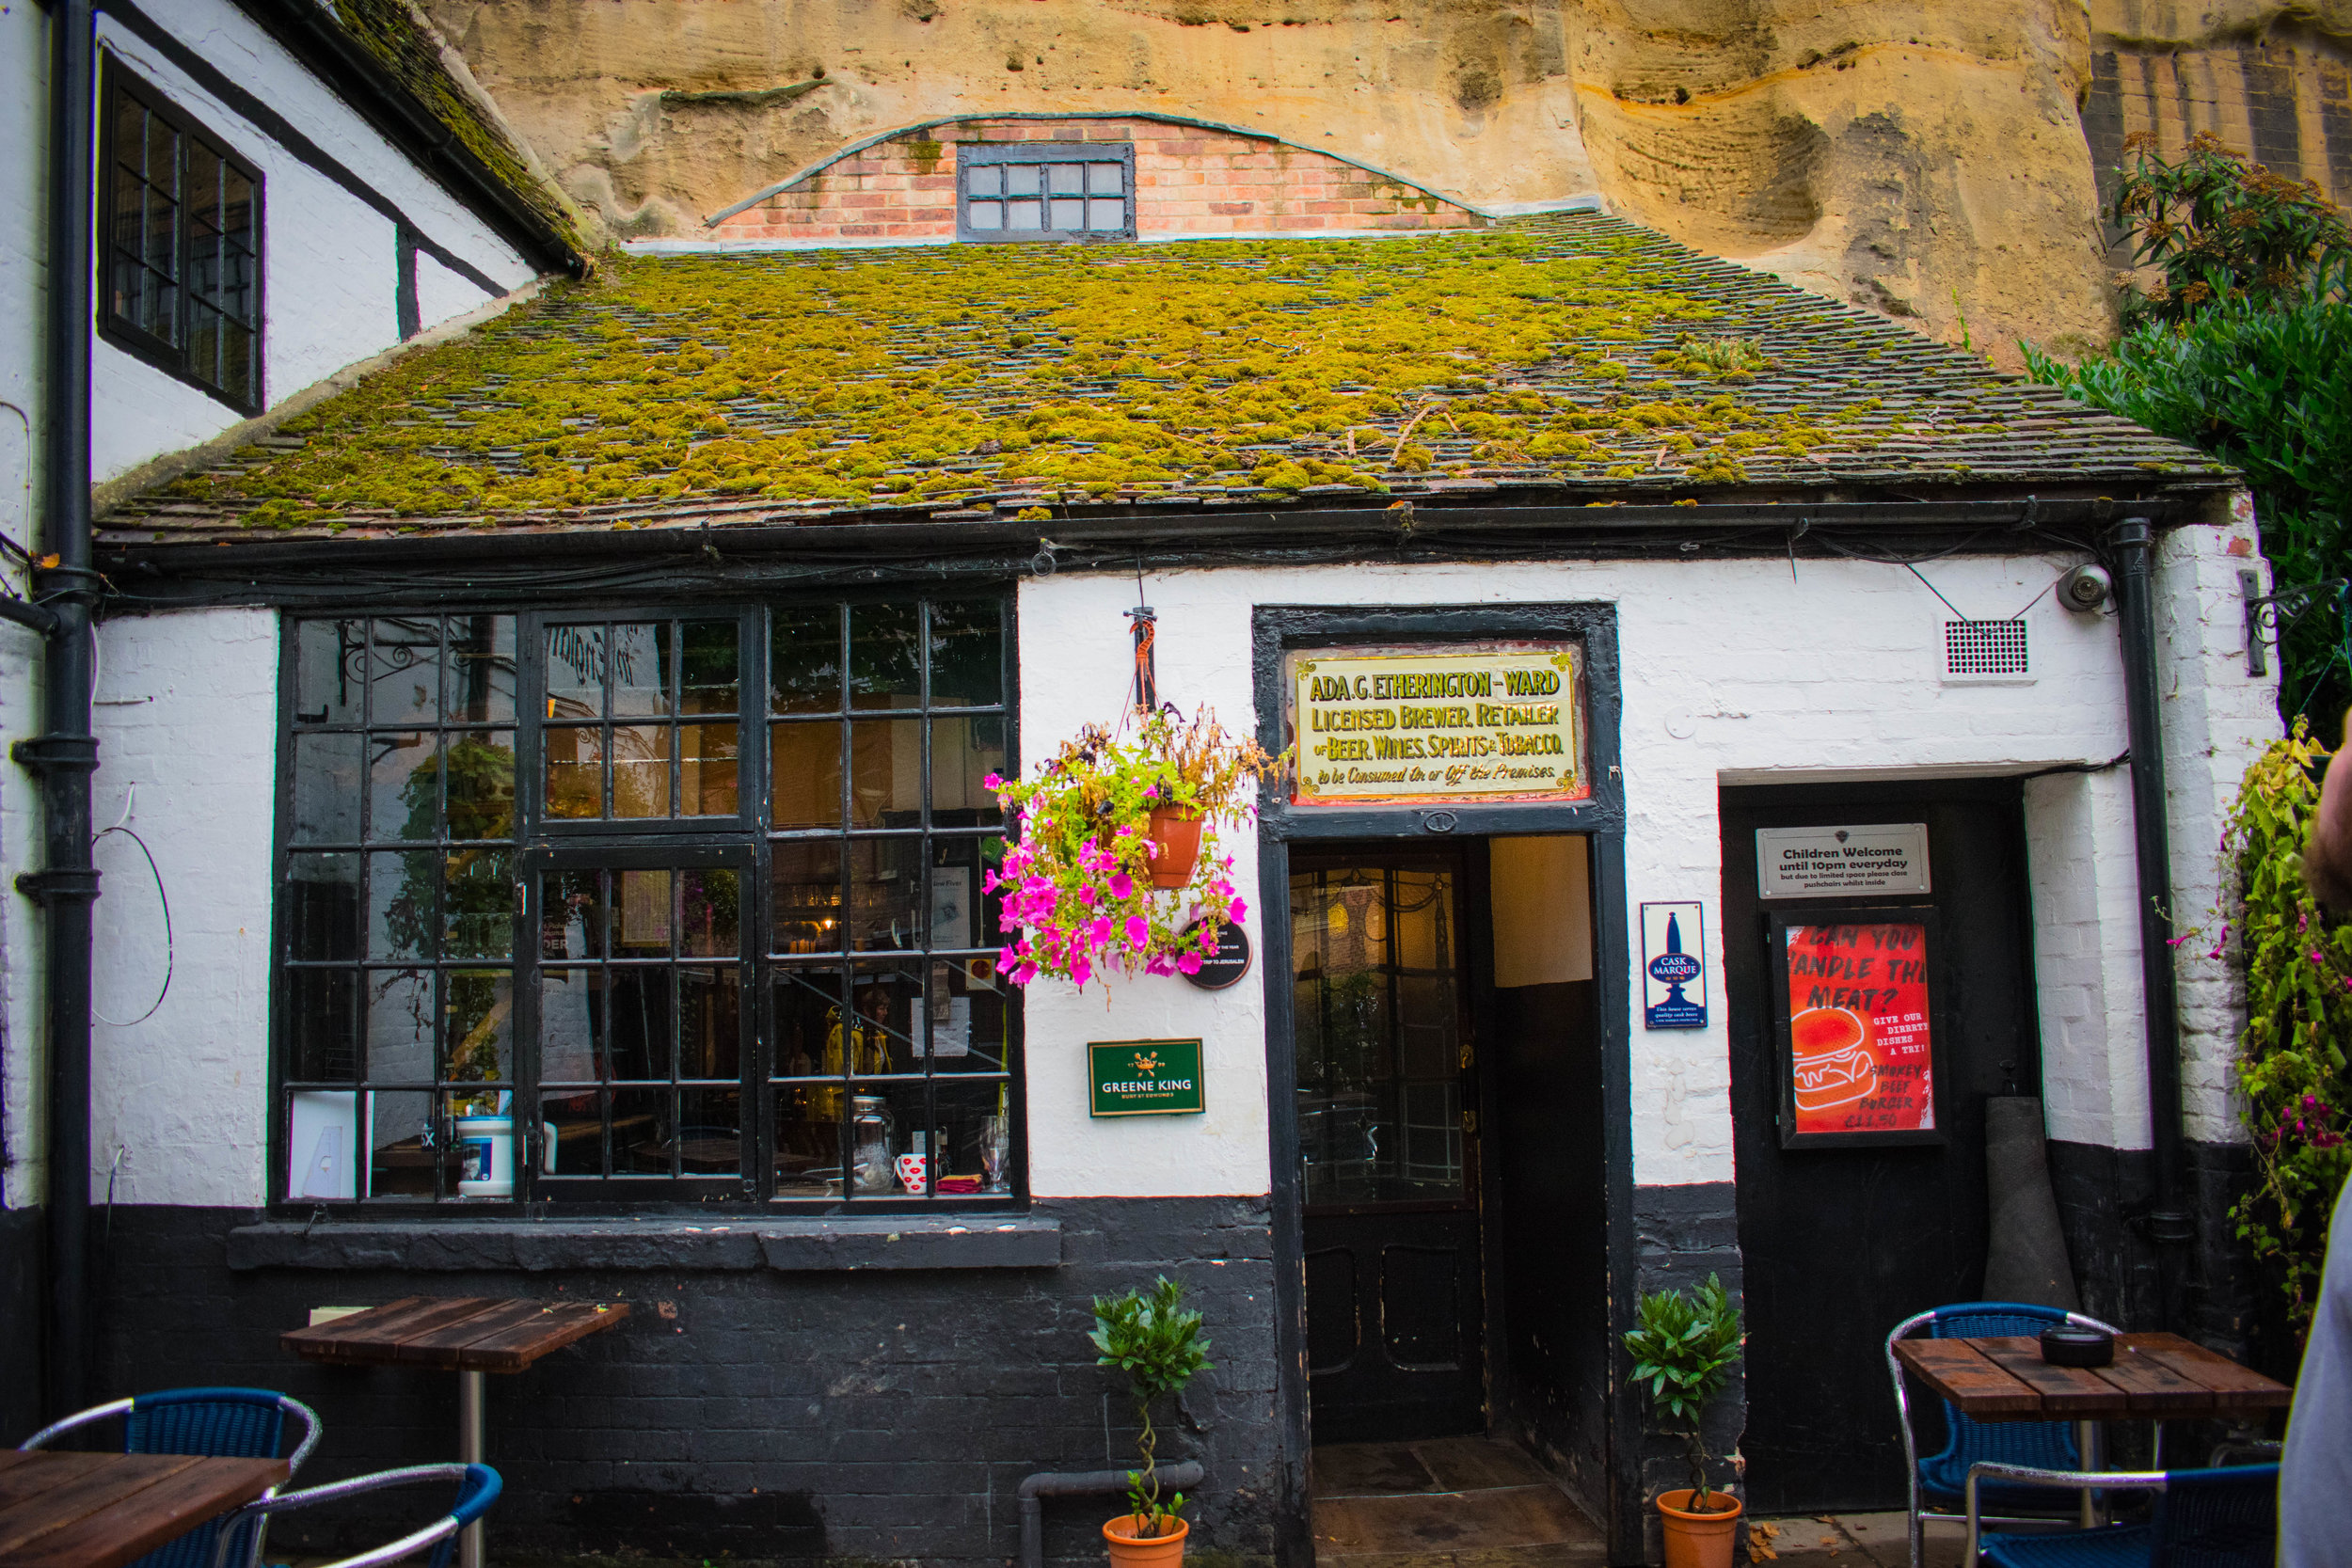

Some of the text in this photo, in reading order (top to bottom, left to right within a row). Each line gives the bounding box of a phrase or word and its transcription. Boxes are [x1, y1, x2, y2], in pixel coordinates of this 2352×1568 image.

[1311, 707, 1397, 732] LICENSED
[1475, 703, 1559, 727] RETAILER
[1313, 744, 1328, 756] OF
[1427, 734, 1489, 759] SPIRITS
[1317, 768, 1330, 784] to
[1331, 767, 1345, 784] be
[1347, 766, 1408, 784] Consumed
[1408, 764, 1425, 783] On
[1427, 769, 1444, 783] or
[1444, 763, 1470, 787] Off
[1469, 763, 1491, 781] the
[1783, 847, 1903, 860] Children Welcome
[1779, 858, 1908, 871] until 10pm everyday
[1809, 927, 1918, 951] CAN YOU
[1661, 957, 1687, 966] CASK
[1806, 985, 1899, 1013] MEAT?
[1873, 1012, 1922, 1025] GIVE OUR
[1886, 1022, 1929, 1035] DIRRRTY
[1877, 1035, 1914, 1047] DISHES
[1901, 1044, 1925, 1054] TRY!
[1869, 1063, 1921, 1079] SMOKEY
[1102, 1079, 1192, 1093] GREENE KING
[1880, 1081, 1911, 1093] BEEF
[1859, 1097, 1913, 1110] BURGER
